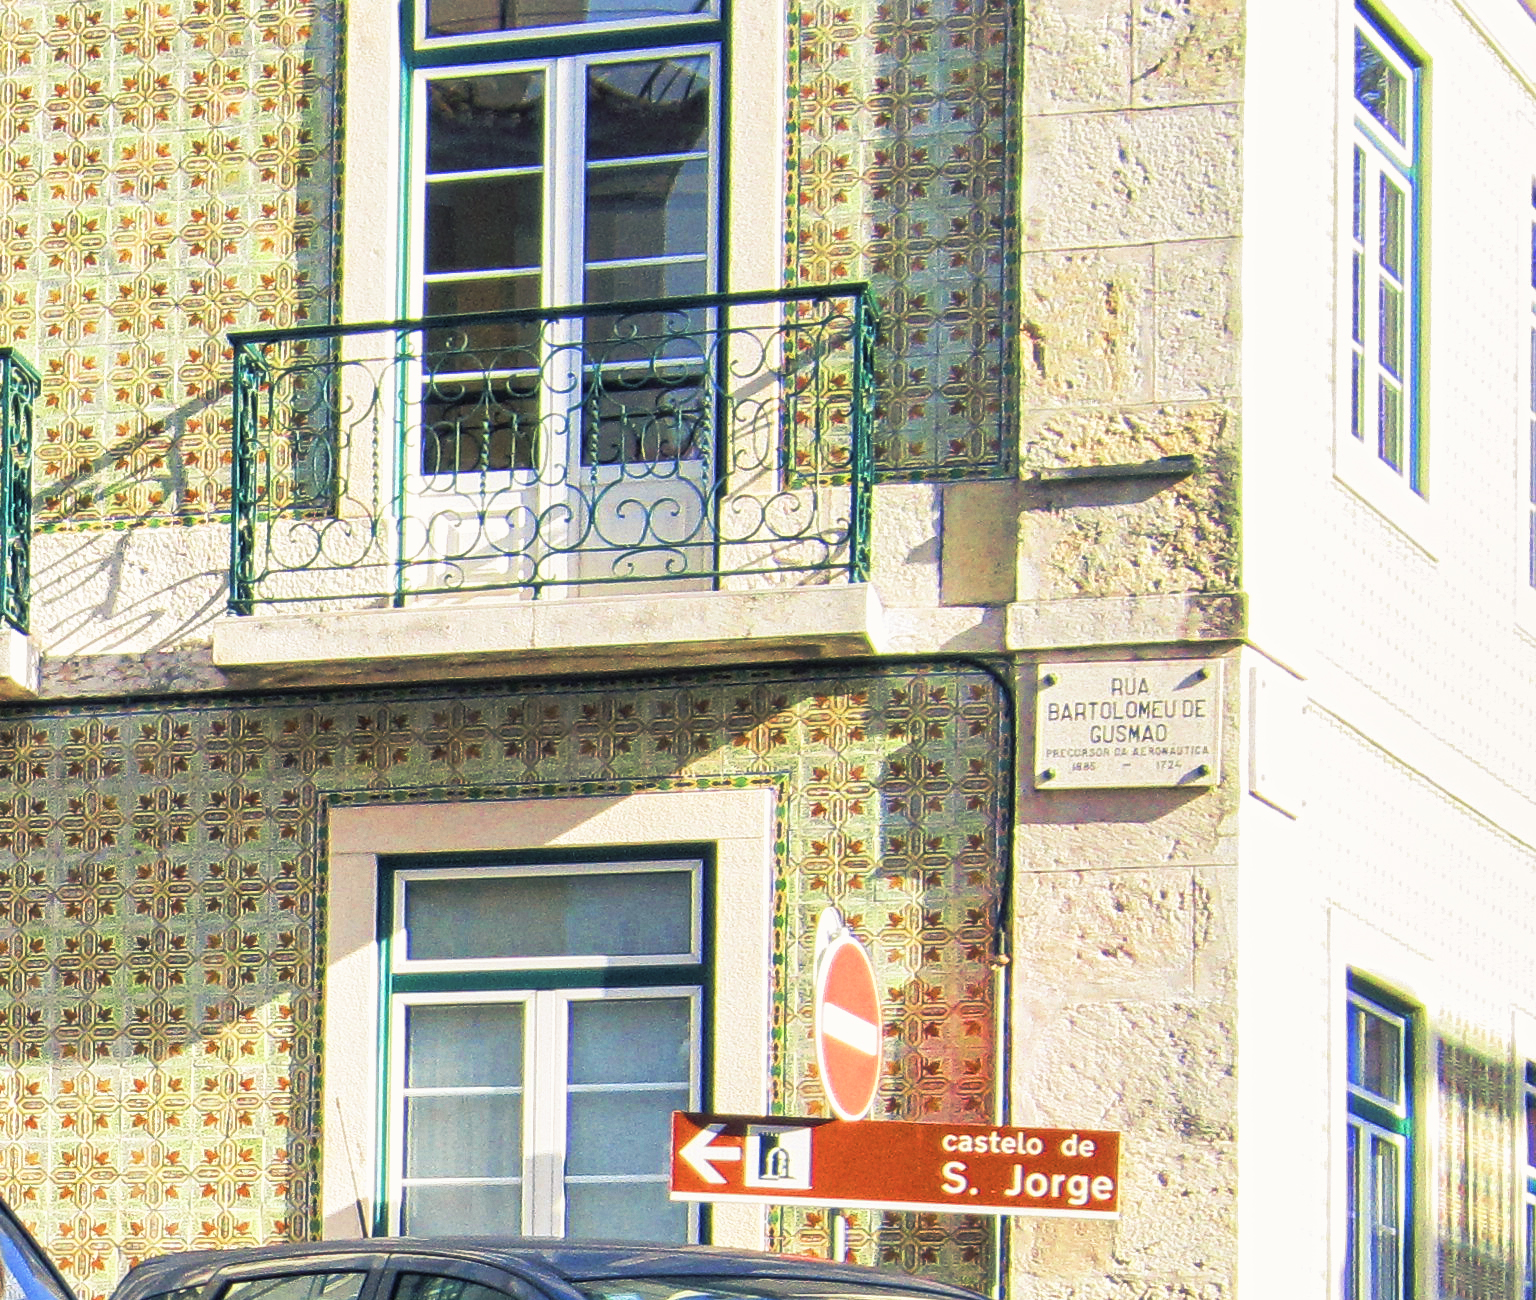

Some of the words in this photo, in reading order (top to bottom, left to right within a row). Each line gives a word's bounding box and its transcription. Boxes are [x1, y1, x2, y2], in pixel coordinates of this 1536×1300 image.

[1111, 677, 1150, 696] RUA
[1047, 700, 1177, 721] BARTOLOMEU
[1182, 699, 1206, 718] DE
[941, 1130, 1044, 1157] castelo
[1060, 1132, 1096, 1158] de
[940, 1161, 979, 1197] S.
[1004, 1163, 1114, 1206] Jorge
